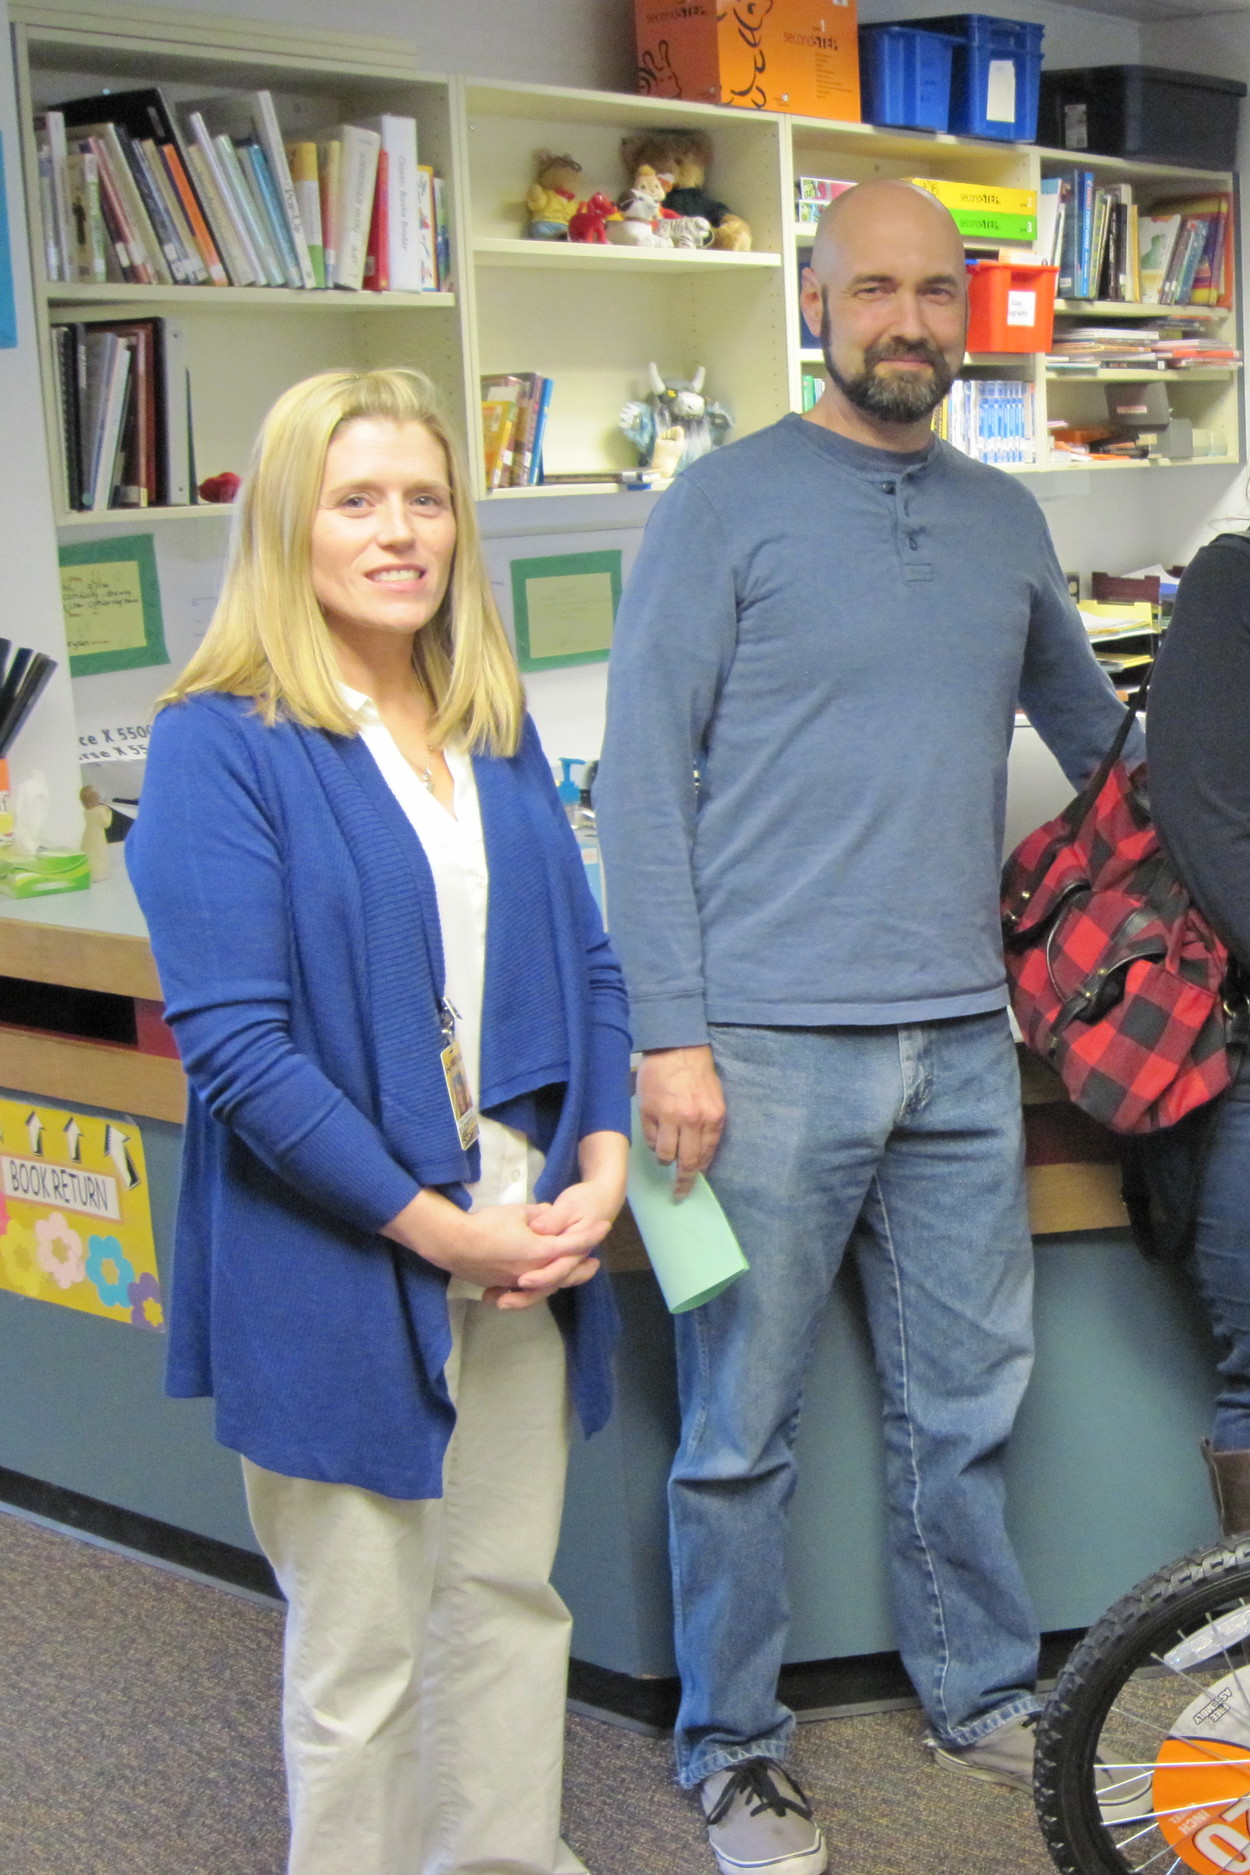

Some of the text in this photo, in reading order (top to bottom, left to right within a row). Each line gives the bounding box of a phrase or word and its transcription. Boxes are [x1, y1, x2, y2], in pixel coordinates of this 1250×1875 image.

[101, 729, 115, 743] X
[10, 1159, 109, 1211] BOOK RETURN
[1211, 1701, 1231, 1723] FREE
[1177, 1808, 1211, 1836] INCH
